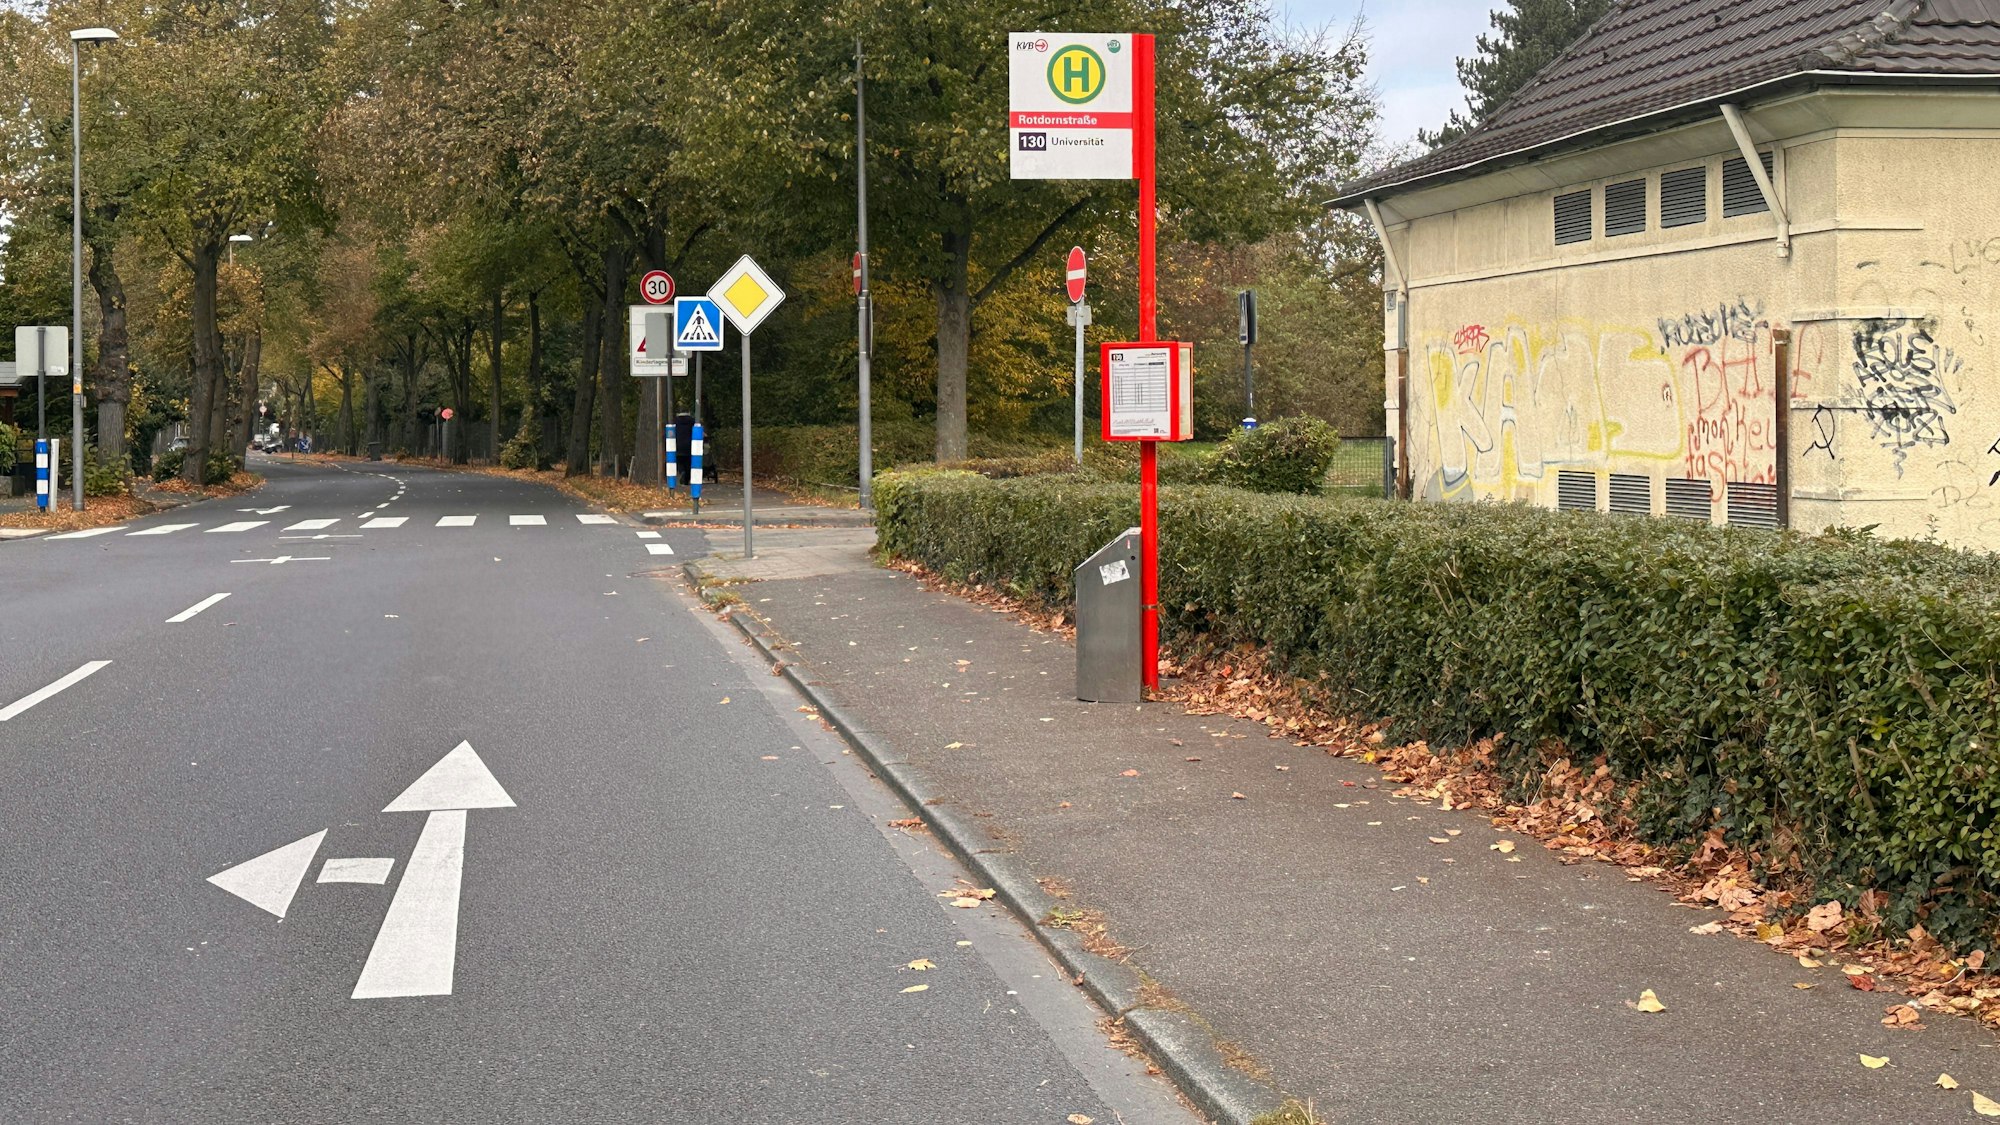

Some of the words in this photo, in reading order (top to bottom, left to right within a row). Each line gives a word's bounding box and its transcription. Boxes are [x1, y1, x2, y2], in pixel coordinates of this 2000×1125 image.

[1016, 41, 1034, 50] KVB
[1064, 57, 1089, 92] H
[1018, 115, 1098, 125] Rotdornstraße
[1020, 135, 1045, 148] 130
[1051, 137, 1104, 146] Universität
[648, 280, 667, 295] 30
